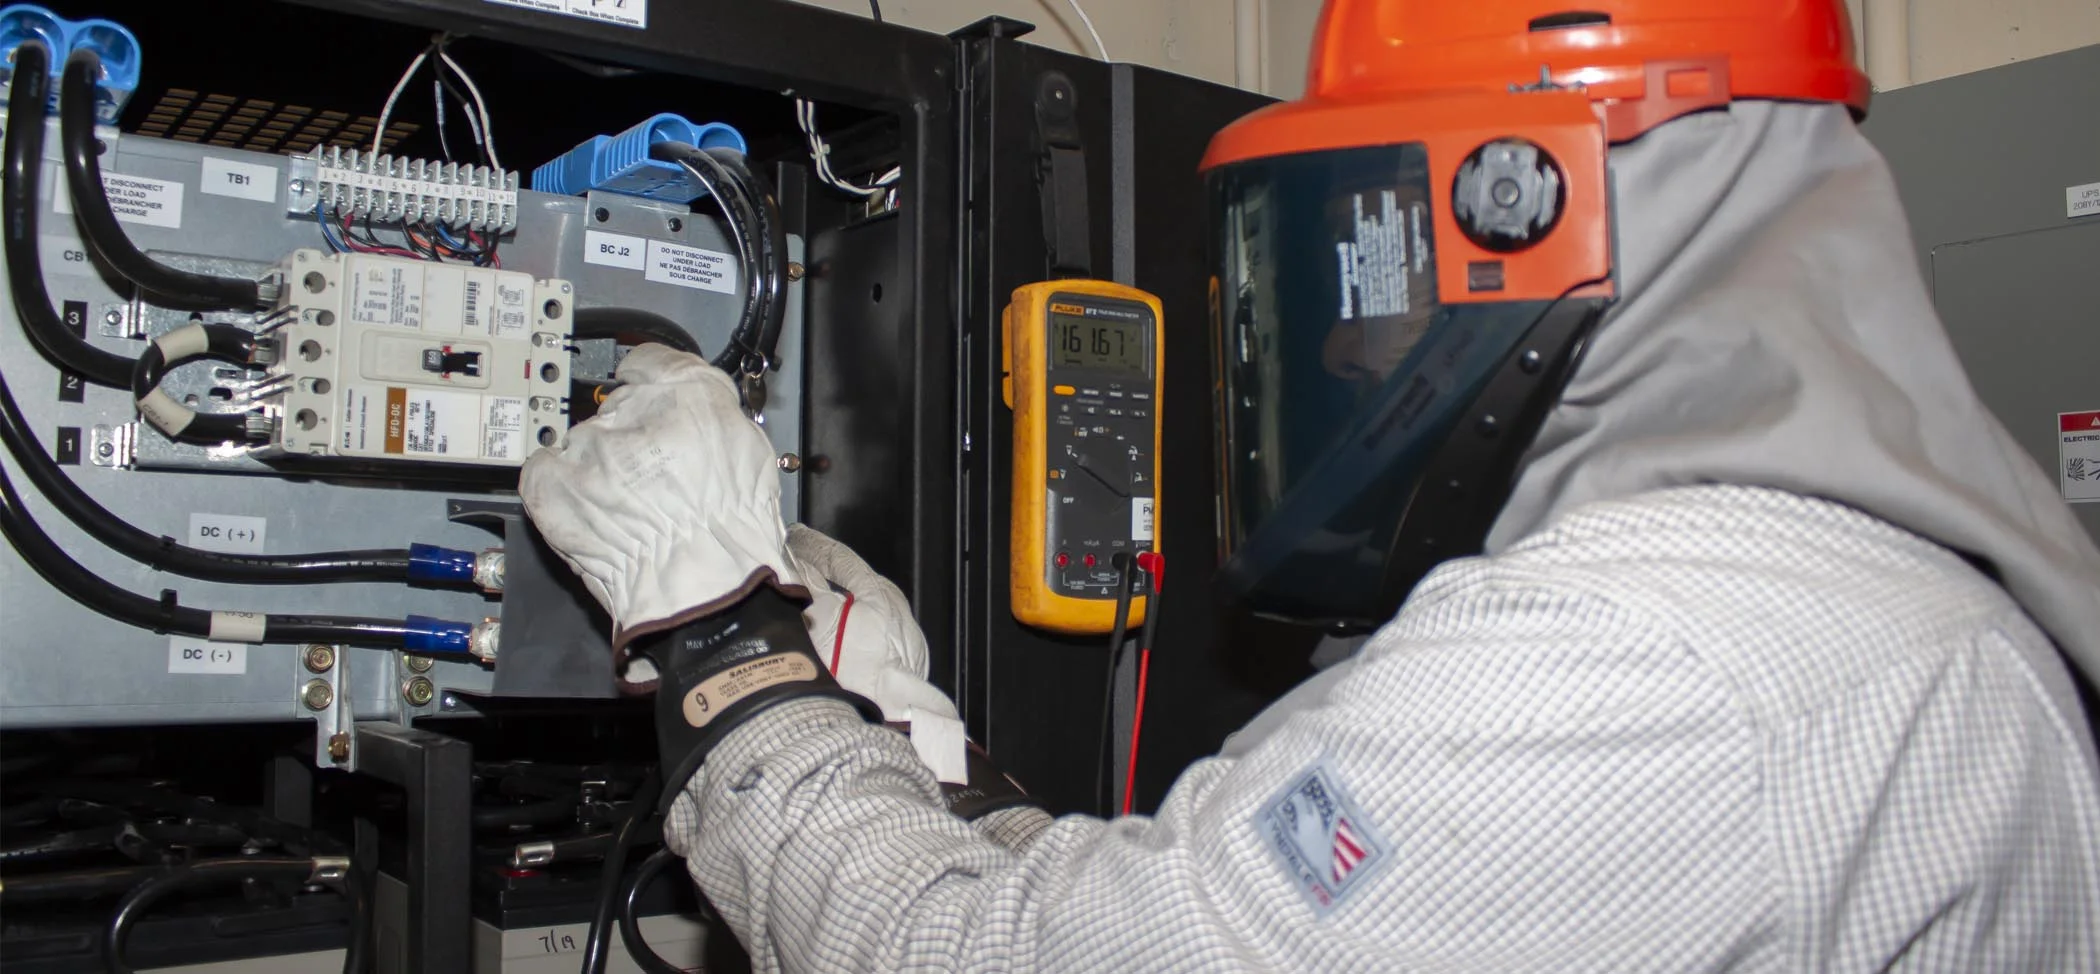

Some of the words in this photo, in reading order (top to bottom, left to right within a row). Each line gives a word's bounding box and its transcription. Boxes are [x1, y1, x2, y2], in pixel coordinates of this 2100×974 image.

[110, 178, 164, 192] DISCONNECT
[226, 172, 250, 186] TB1
[123, 190, 146, 198] LOAD
[112, 206, 148, 217] CHARGE
[600, 244, 616, 254] BC
[618, 246, 630, 257] J2
[686, 251, 723, 263] DISCONNECT
[670, 264, 682, 272] PAS
[672, 257, 694, 266] UNDER
[694, 260, 711, 268] LOAD
[669, 272, 686, 280] SOUS
[687, 274, 712, 284] CHARGE
[68, 311, 80, 326] 3
[66, 375, 78, 390] 2
[66, 438, 74, 452] 1
[201, 526, 220, 539] DC
[183, 648, 202, 660] DC
[729, 656, 786, 678] SALISBURY
[538, 929, 576, 952] 7/19
